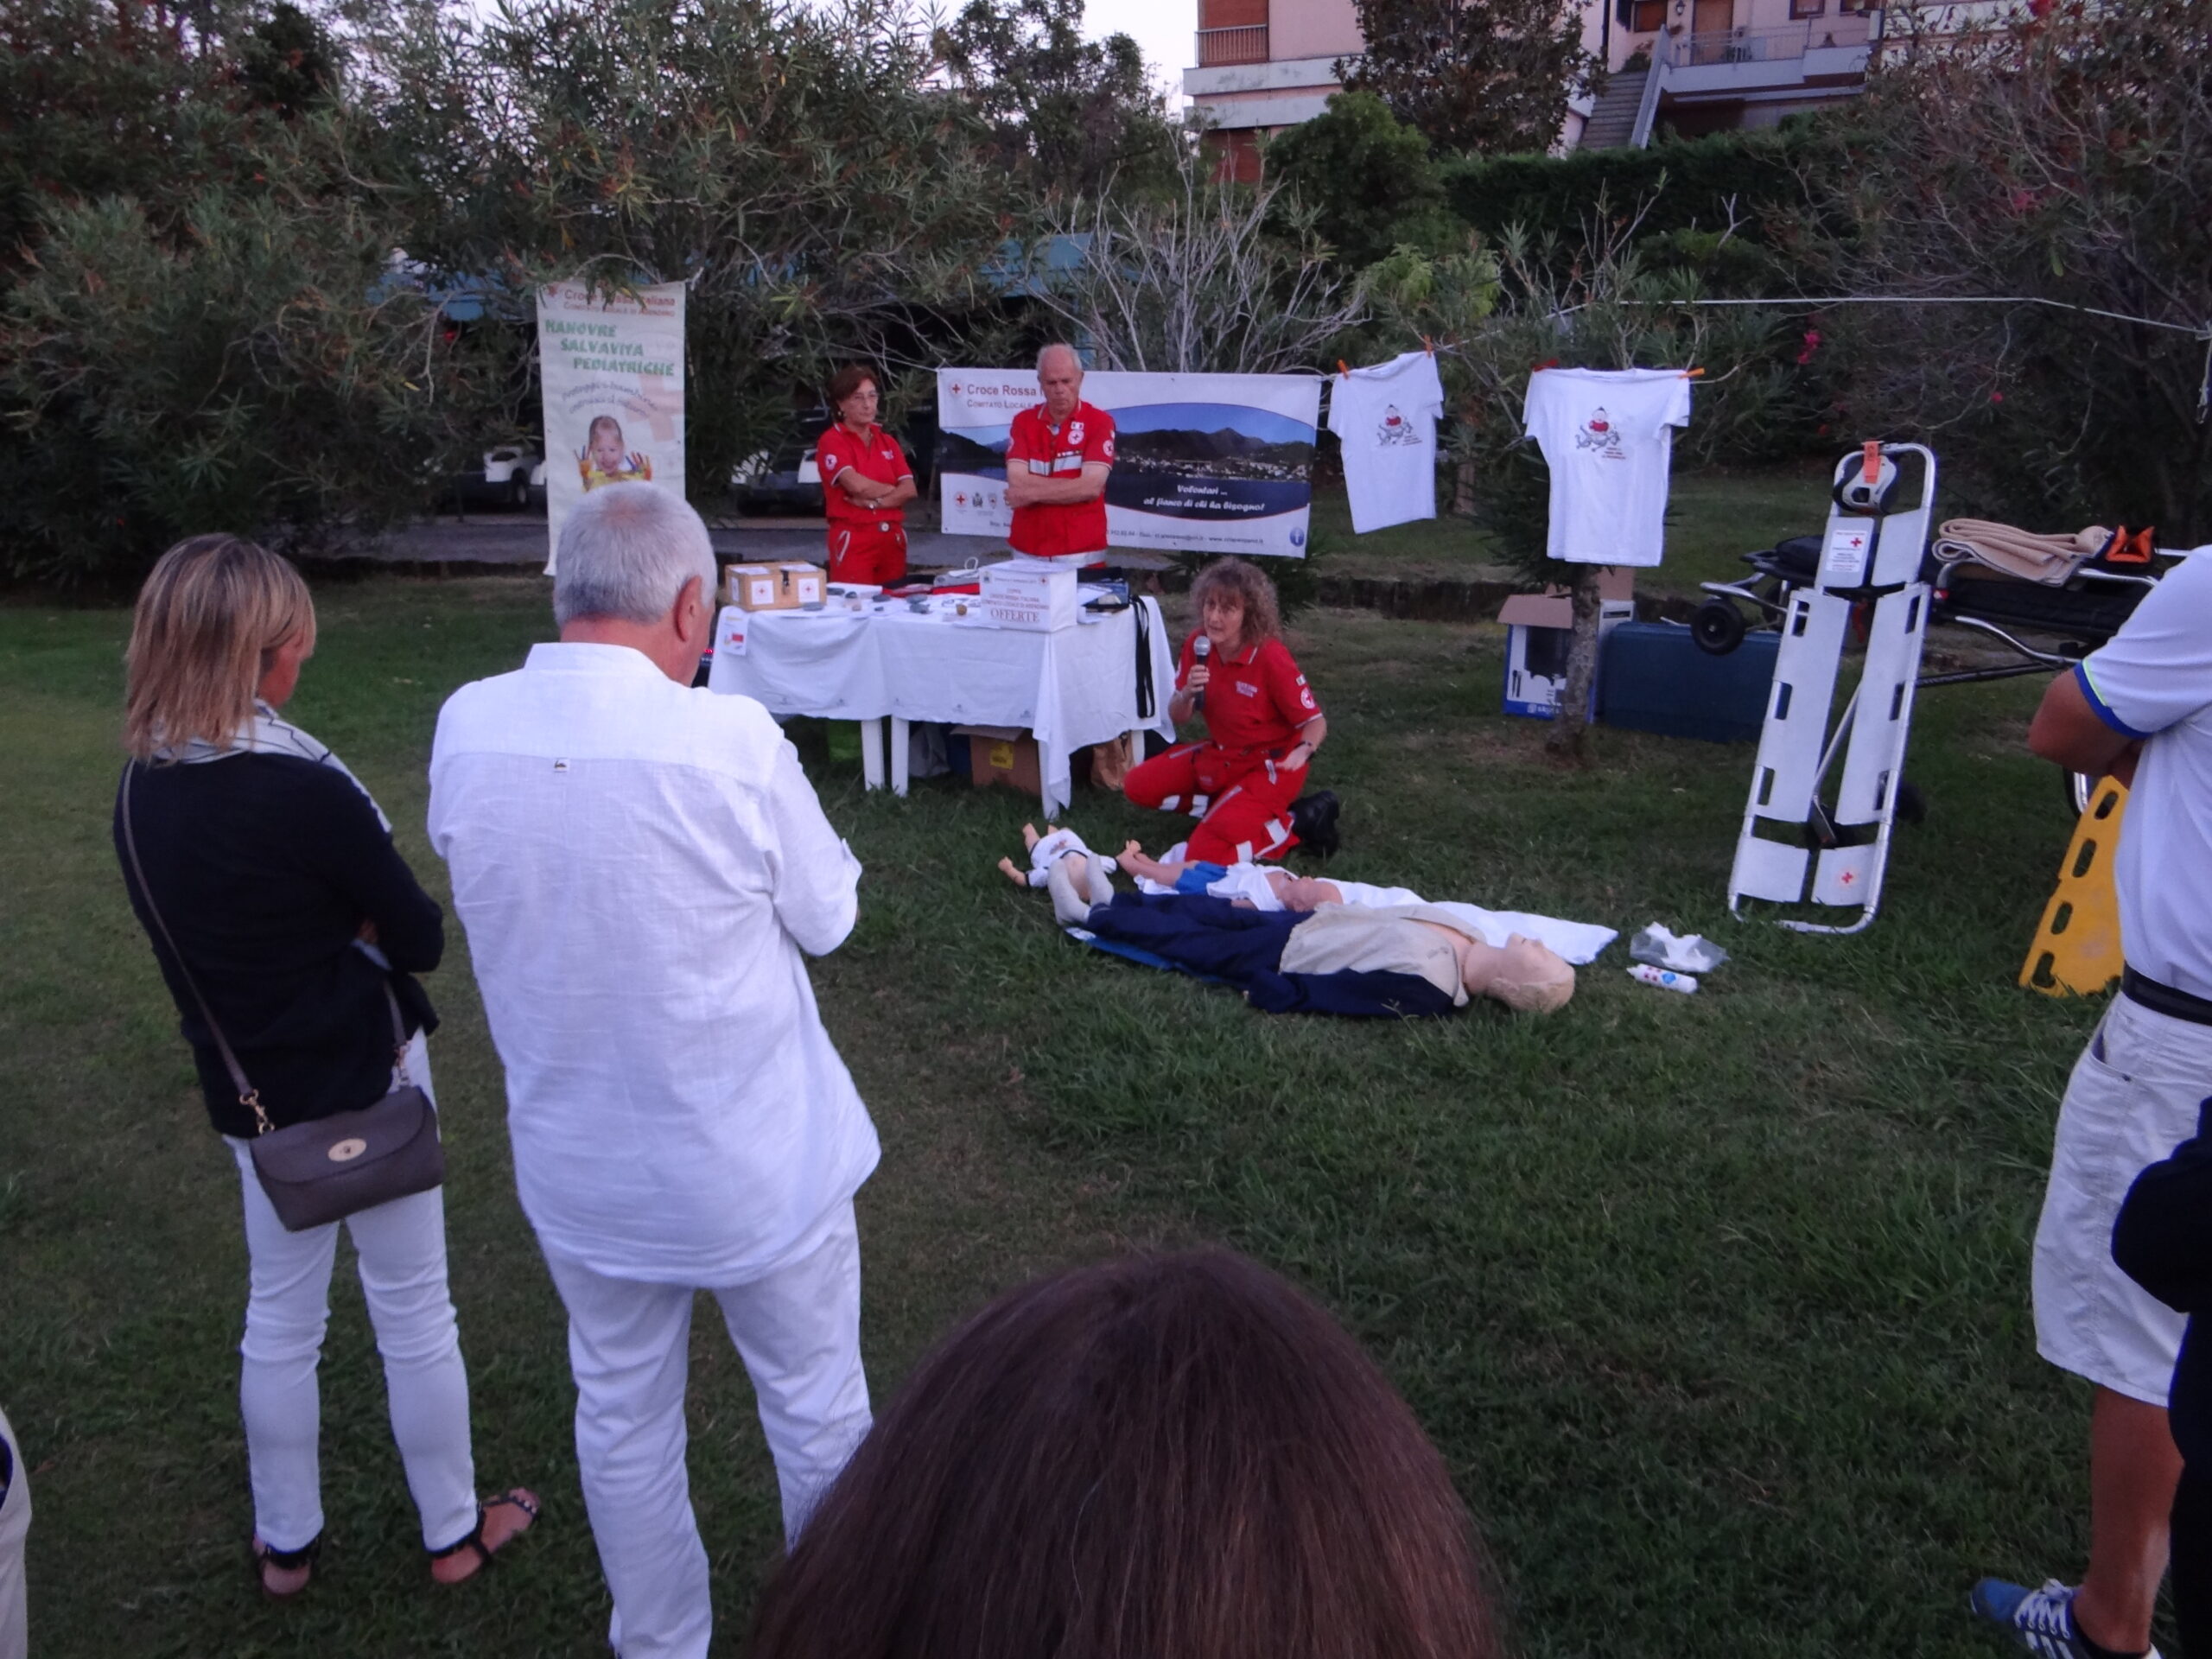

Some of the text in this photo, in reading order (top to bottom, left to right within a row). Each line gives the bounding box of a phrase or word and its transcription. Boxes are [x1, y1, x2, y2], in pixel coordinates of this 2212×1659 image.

[544, 320, 617, 337] MANOVRE
[560, 338, 644, 356] SALVAVITA
[573, 357, 675, 376] PEDIATRICHE
[967, 385, 999, 395] Croce
[1002, 385, 1037, 396] Rossa
[1177, 485, 1218, 495] Volontari
[1156, 498, 1183, 507] fianco
[1224, 502, 1265, 512] bisogno!
[990, 608, 1039, 622] OFFERTE
